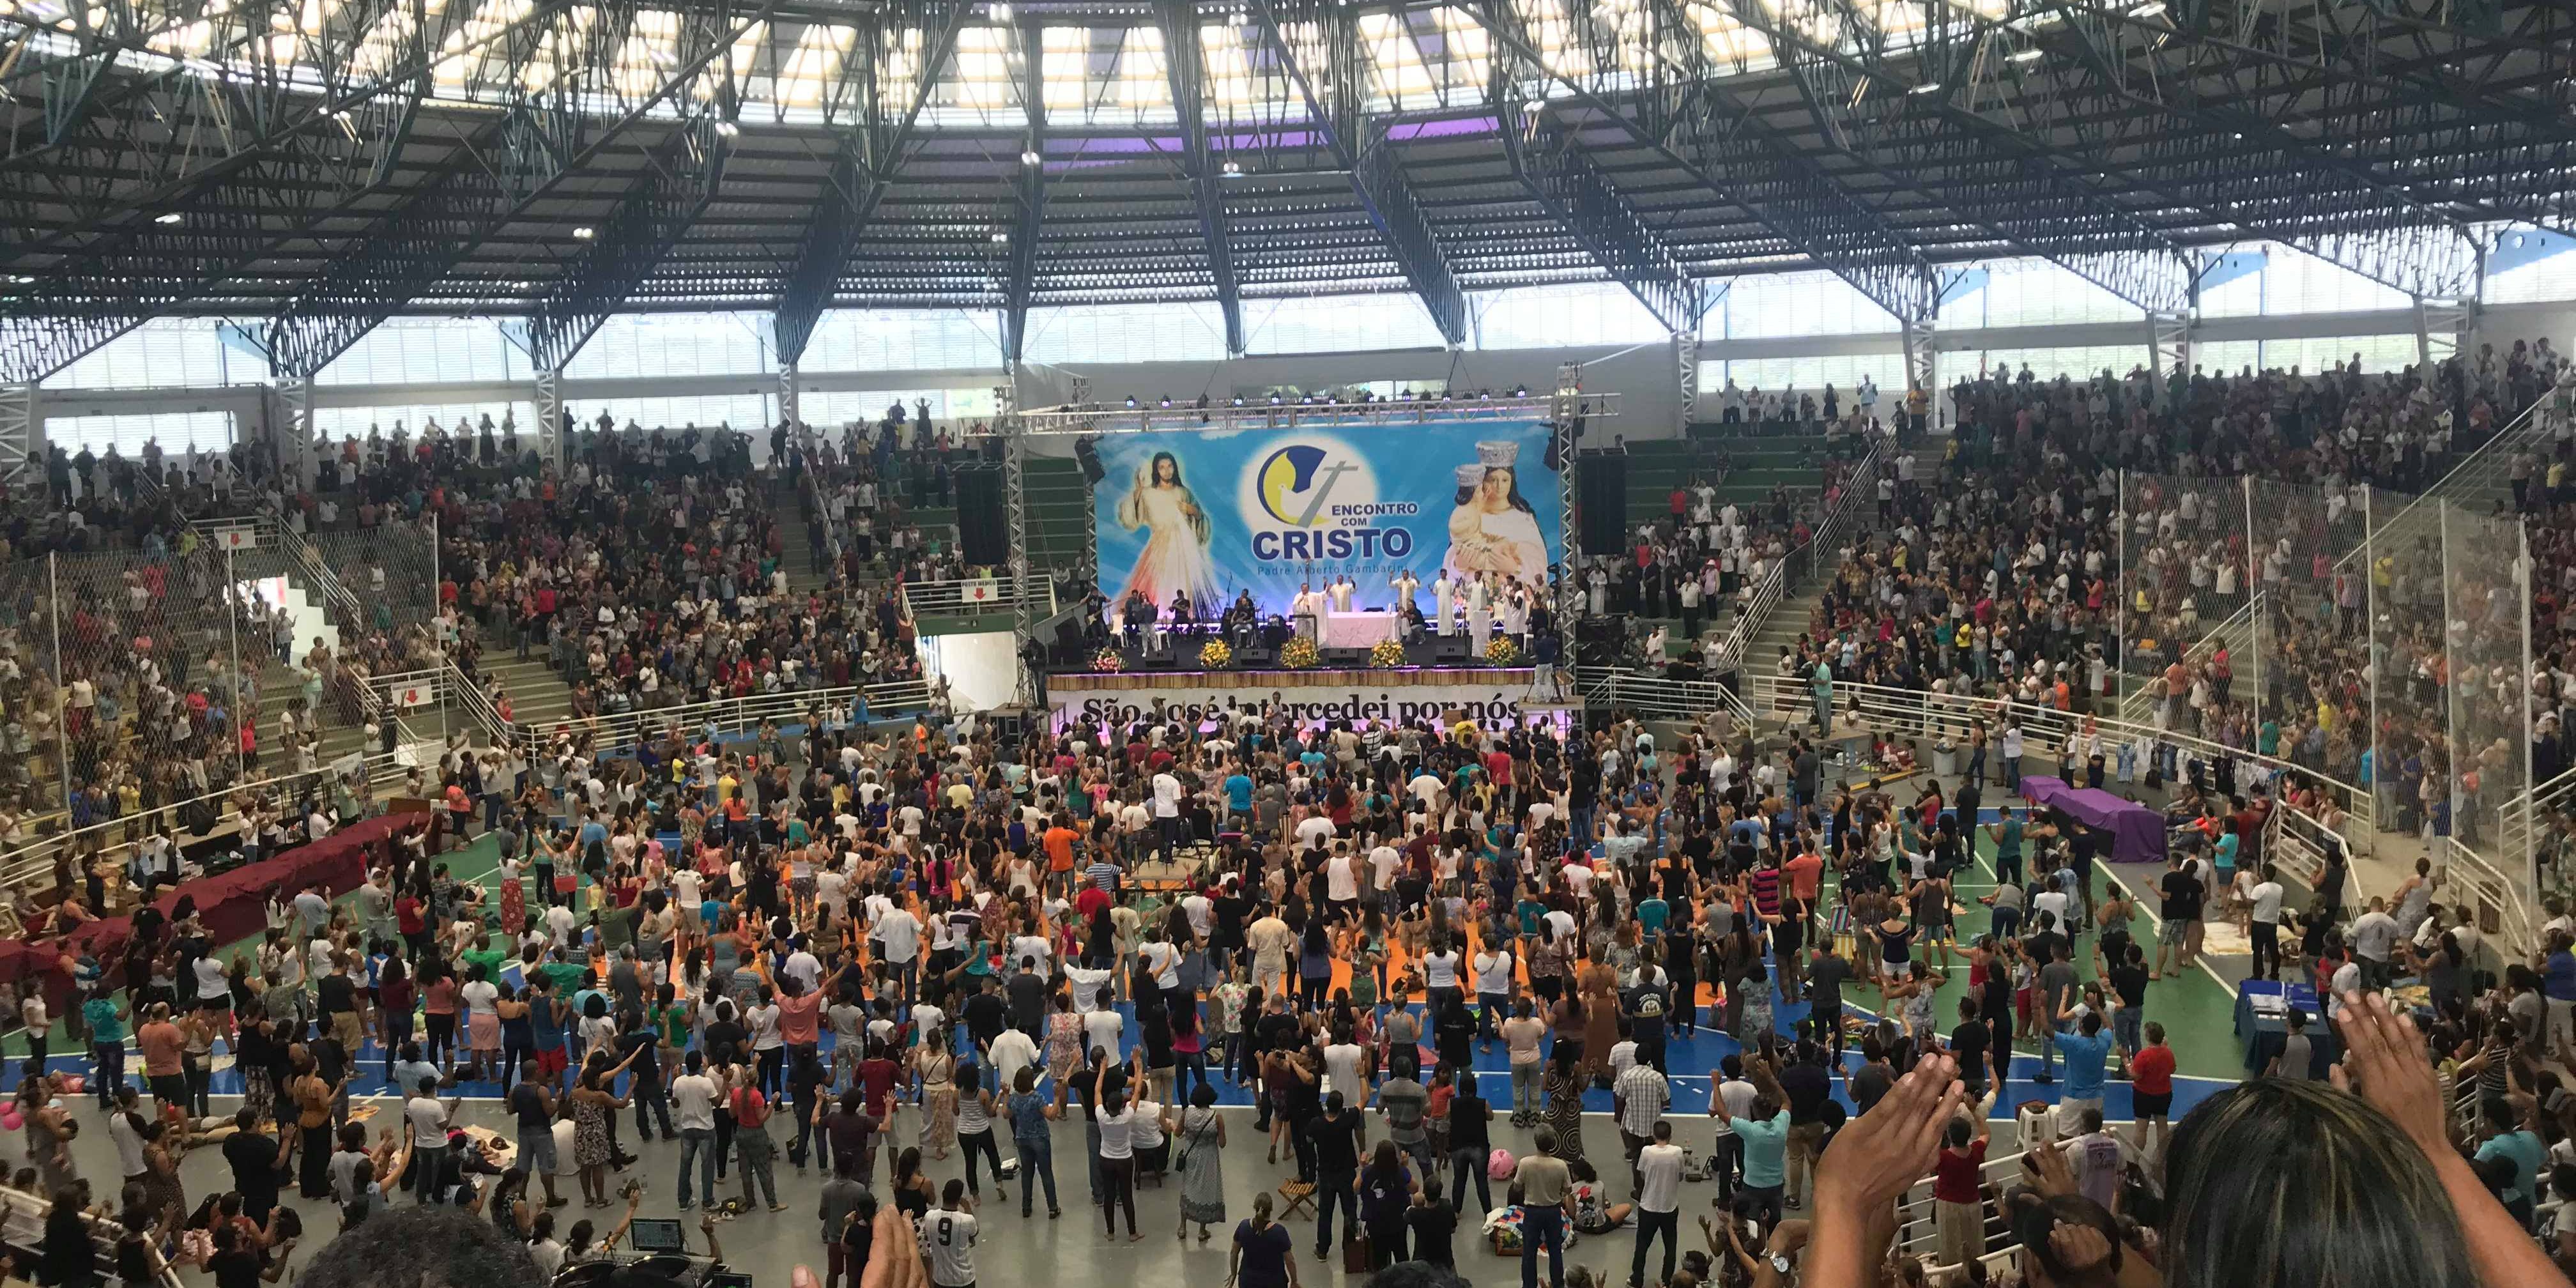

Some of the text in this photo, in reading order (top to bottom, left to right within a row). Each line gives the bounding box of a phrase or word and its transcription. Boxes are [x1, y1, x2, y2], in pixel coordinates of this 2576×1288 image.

[1331, 503, 1418, 516] ENCONTRO
[1341, 518, 1367, 526] COM
[1252, 528, 1412, 560] CRISTO
[1258, 566, 1290, 575] Padre
[1397, 702, 1457, 726] por
[938, 1217, 953, 1246] 9
